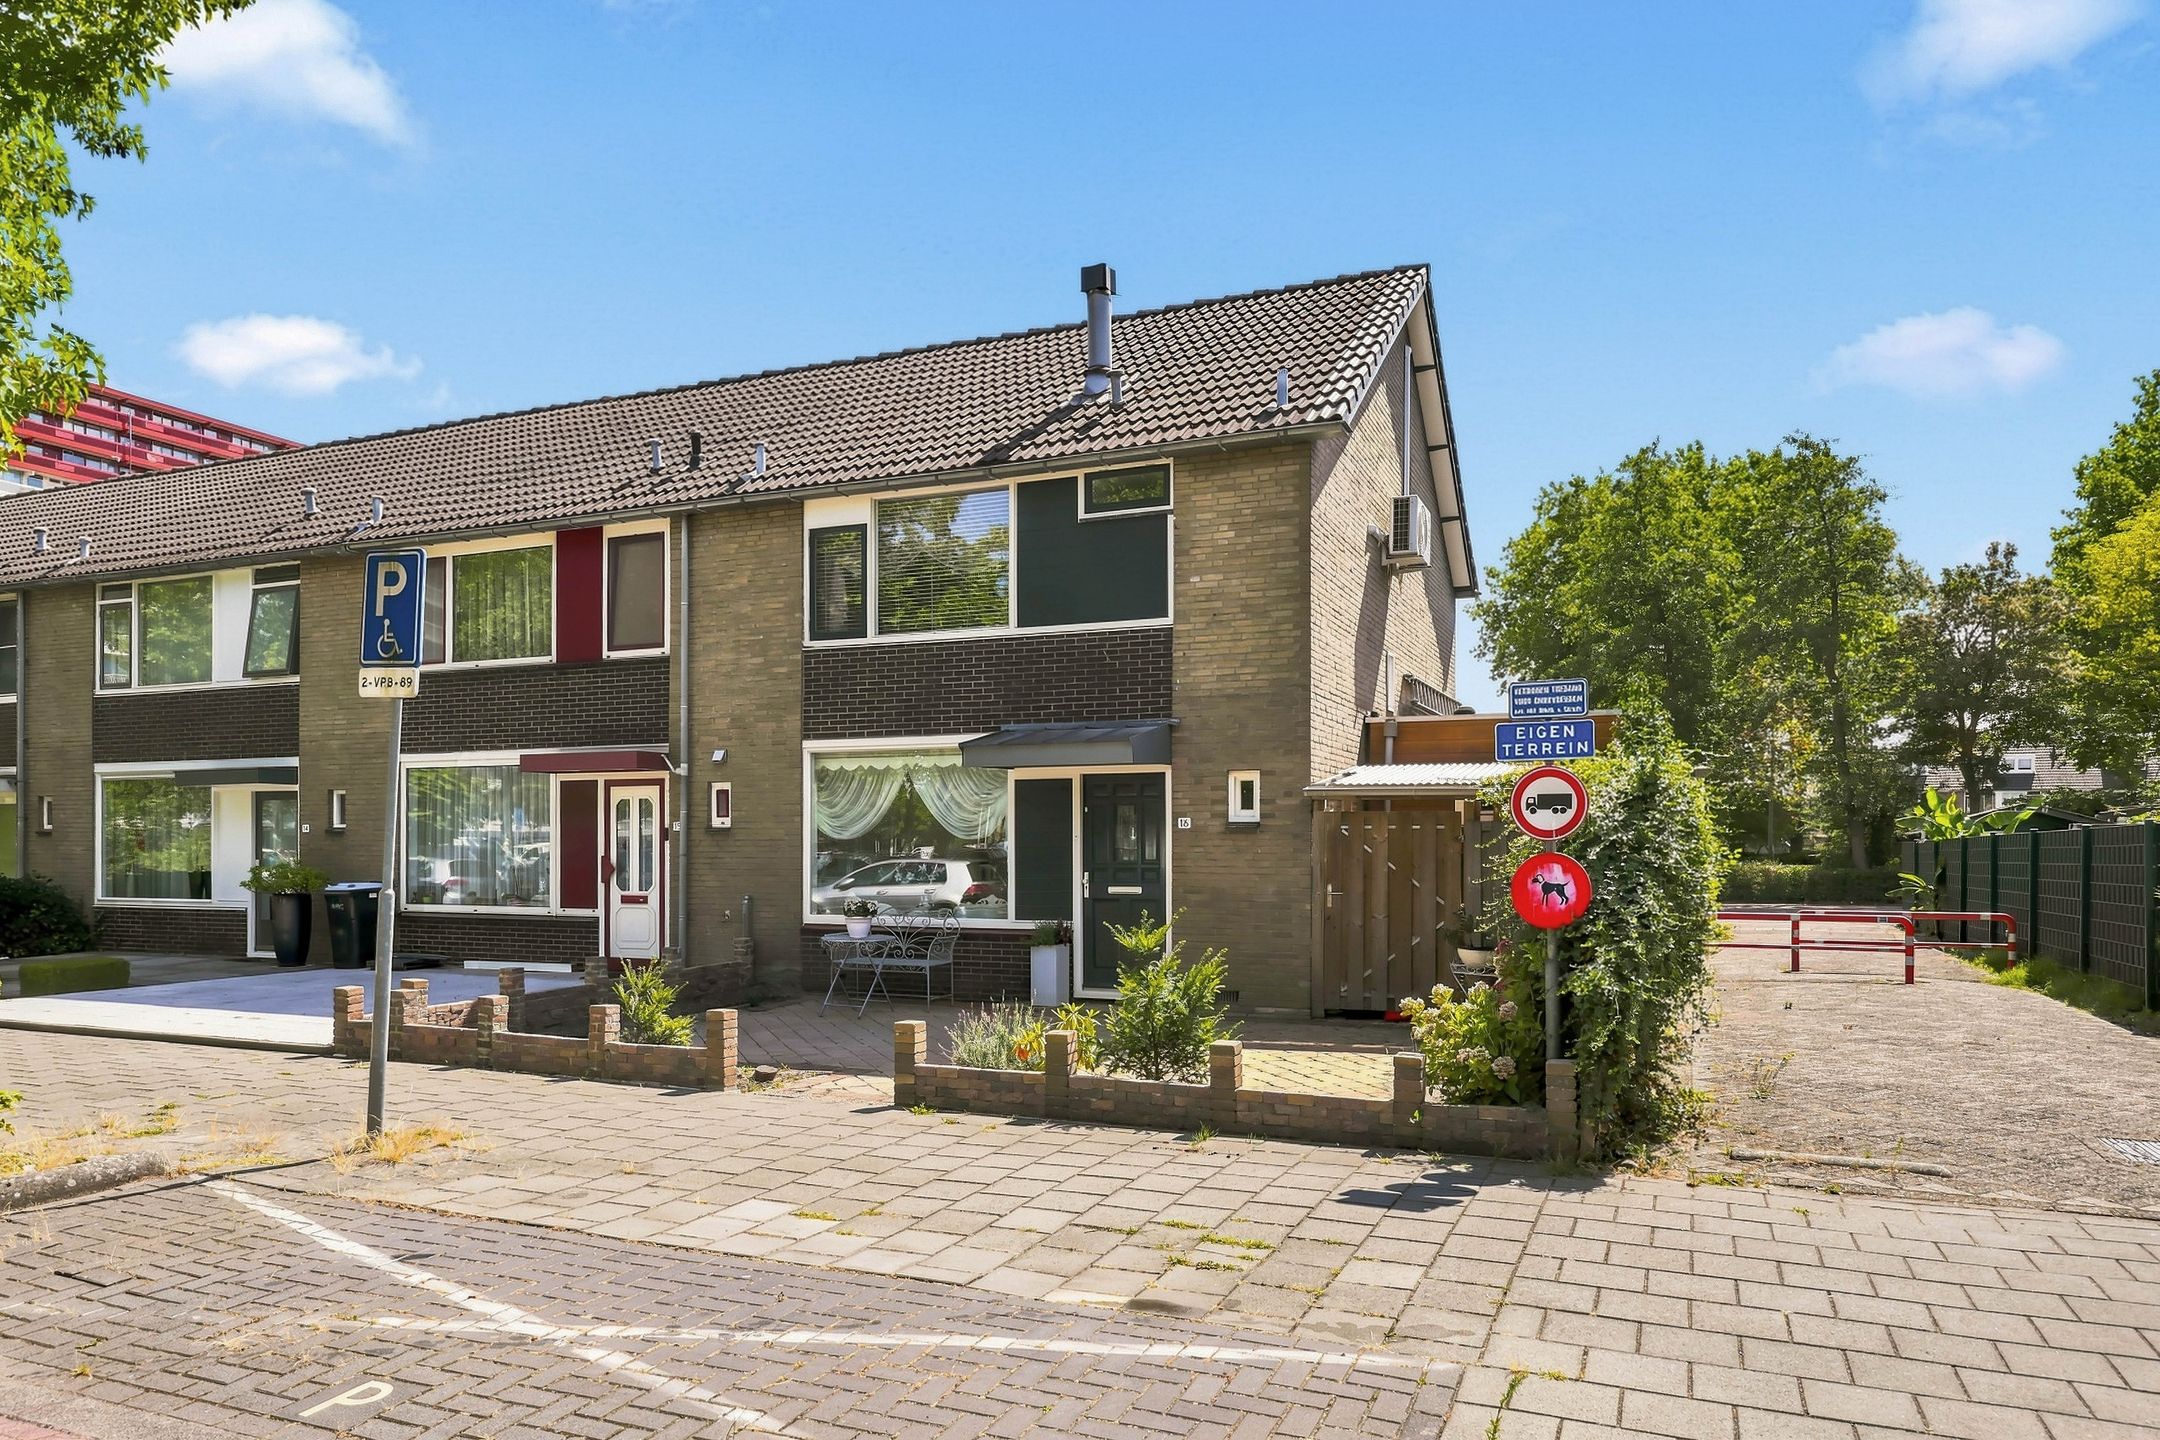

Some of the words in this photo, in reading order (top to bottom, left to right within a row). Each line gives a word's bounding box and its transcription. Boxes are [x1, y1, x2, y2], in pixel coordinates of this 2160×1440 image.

[375, 561, 407, 616] P
[1516, 725, 1574, 740] EIGEN
[1502, 741, 1588, 756] TERREIN
[299, 1380, 394, 1418] P
